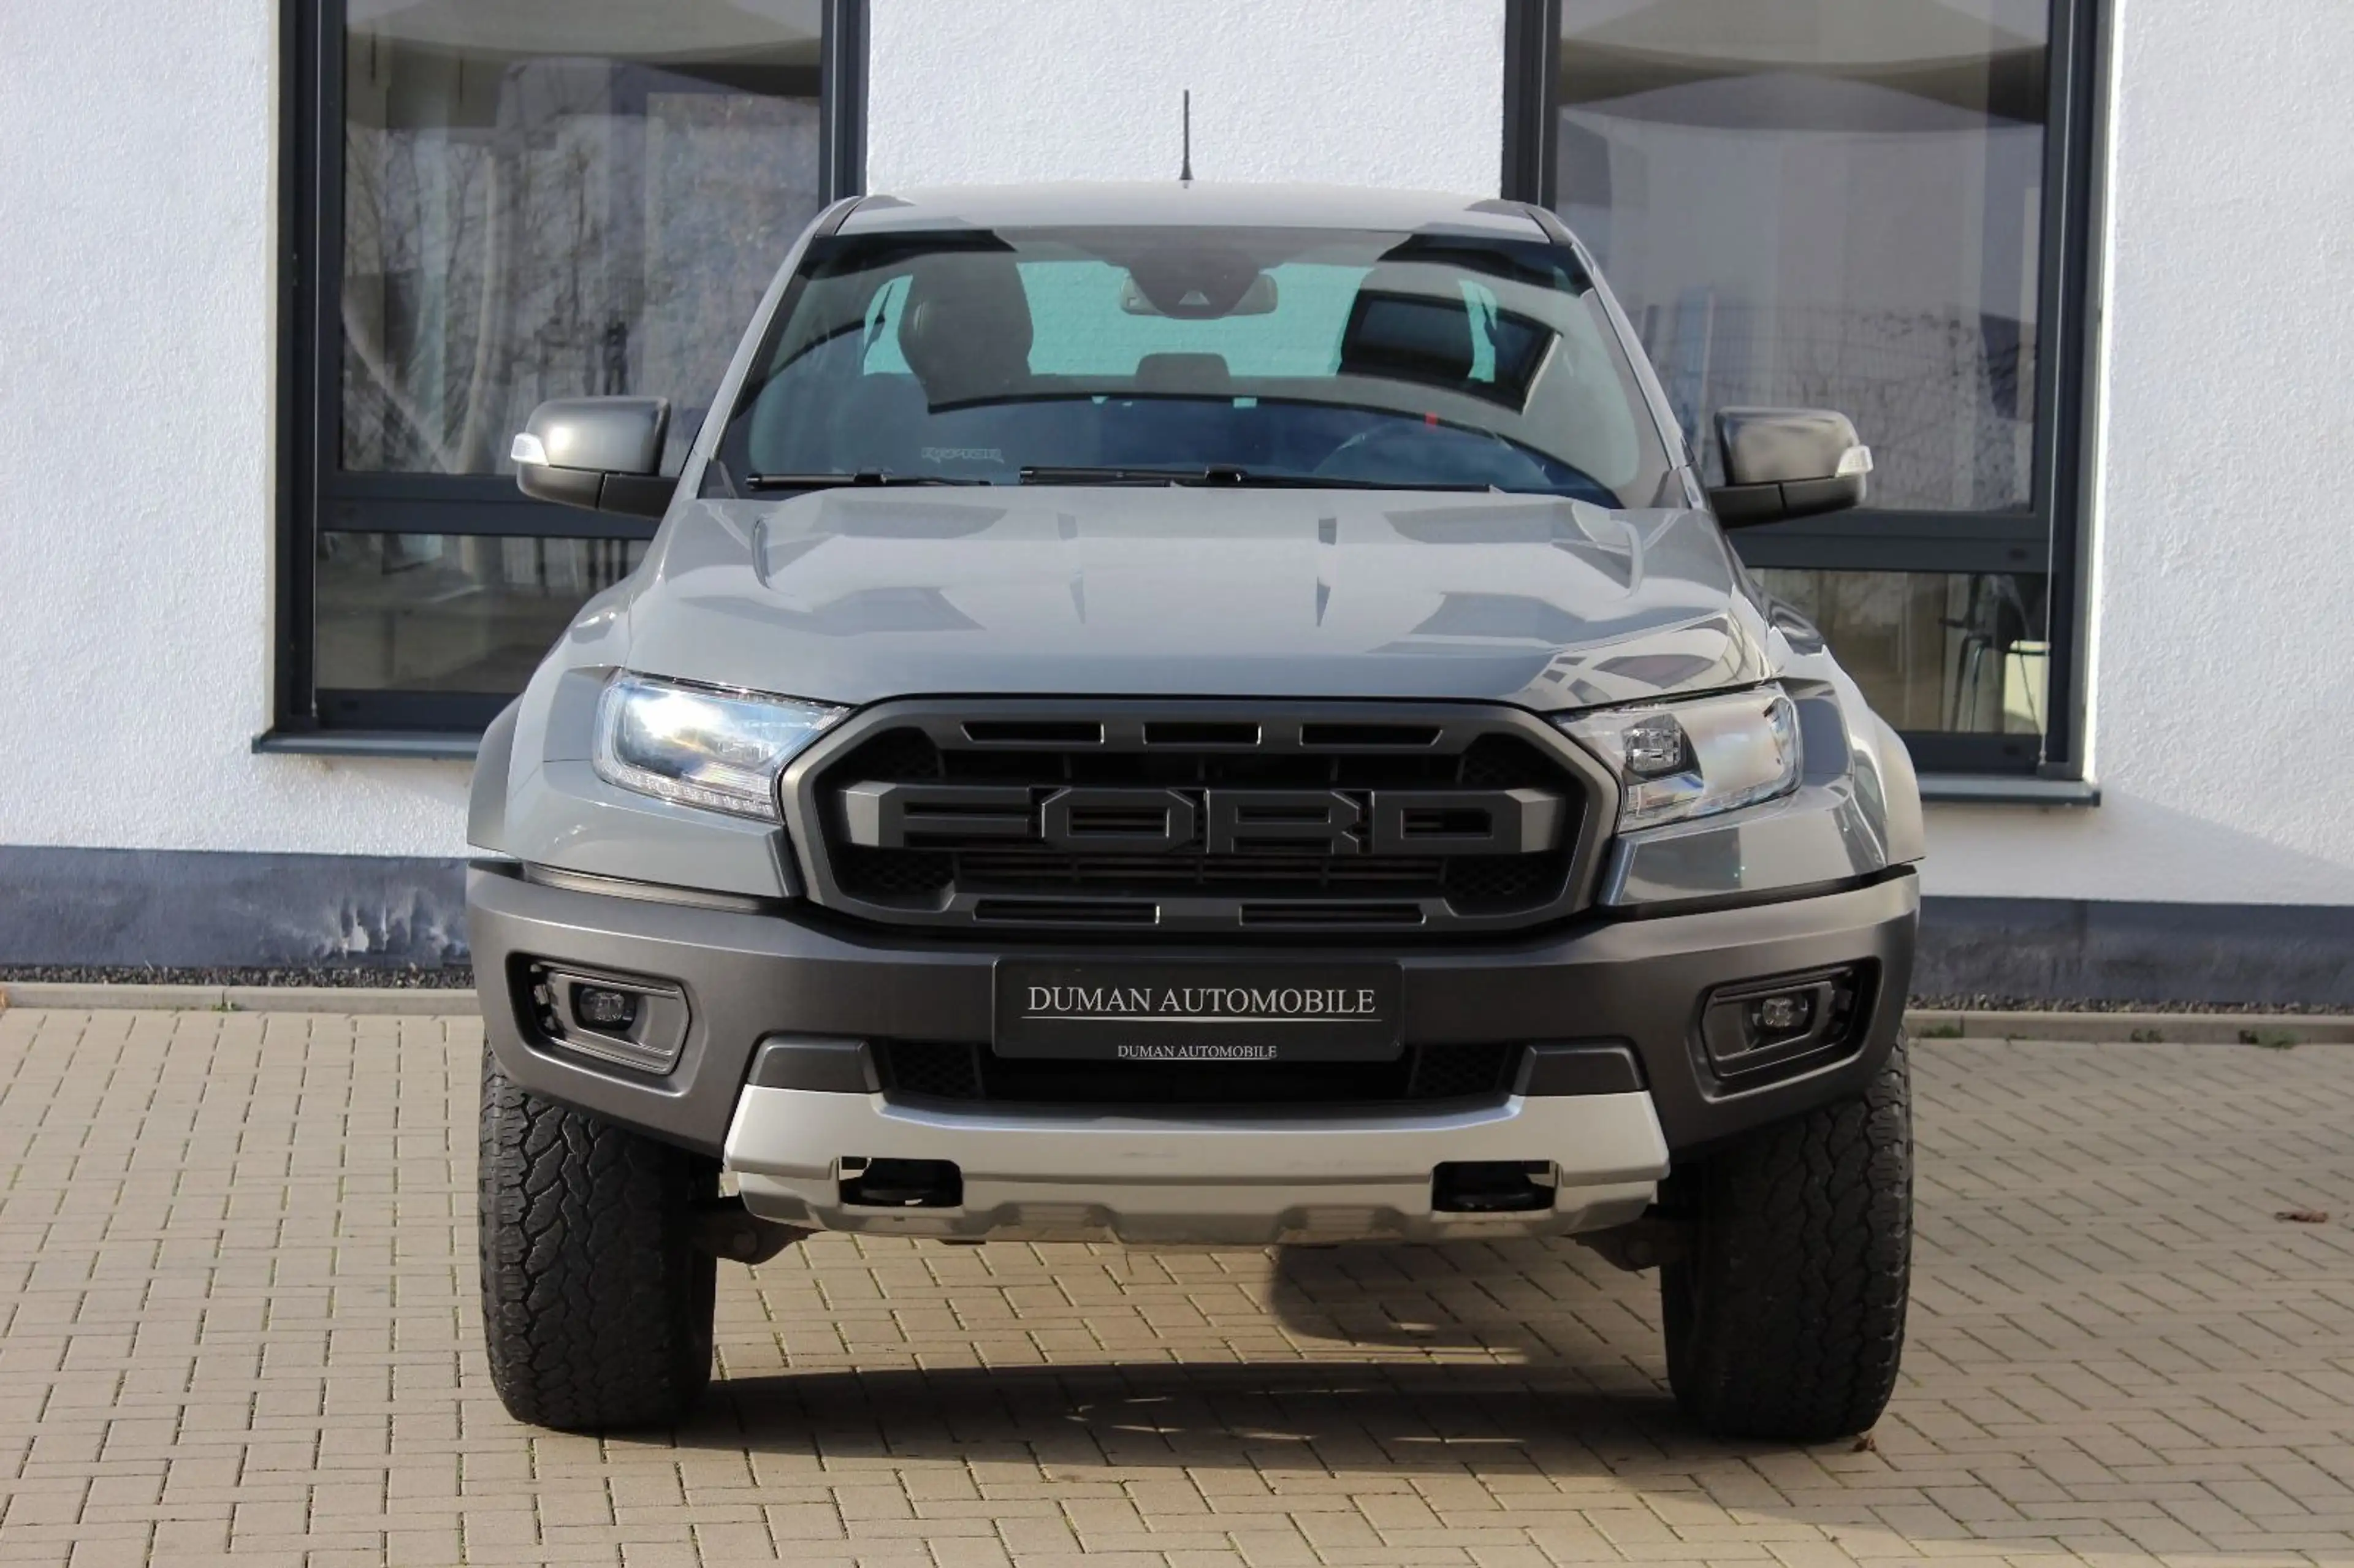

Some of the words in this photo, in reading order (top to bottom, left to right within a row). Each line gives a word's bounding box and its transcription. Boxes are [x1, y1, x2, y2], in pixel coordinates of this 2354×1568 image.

[842, 780, 1567, 854] FORD
[1028, 986, 1152, 1011] DUMAN
[1158, 988, 1376, 1013] AUTOMOBILE
[1118, 1045, 1175, 1057] DUMAN
[1177, 1045, 1277, 1058] AUTOMOBILE
